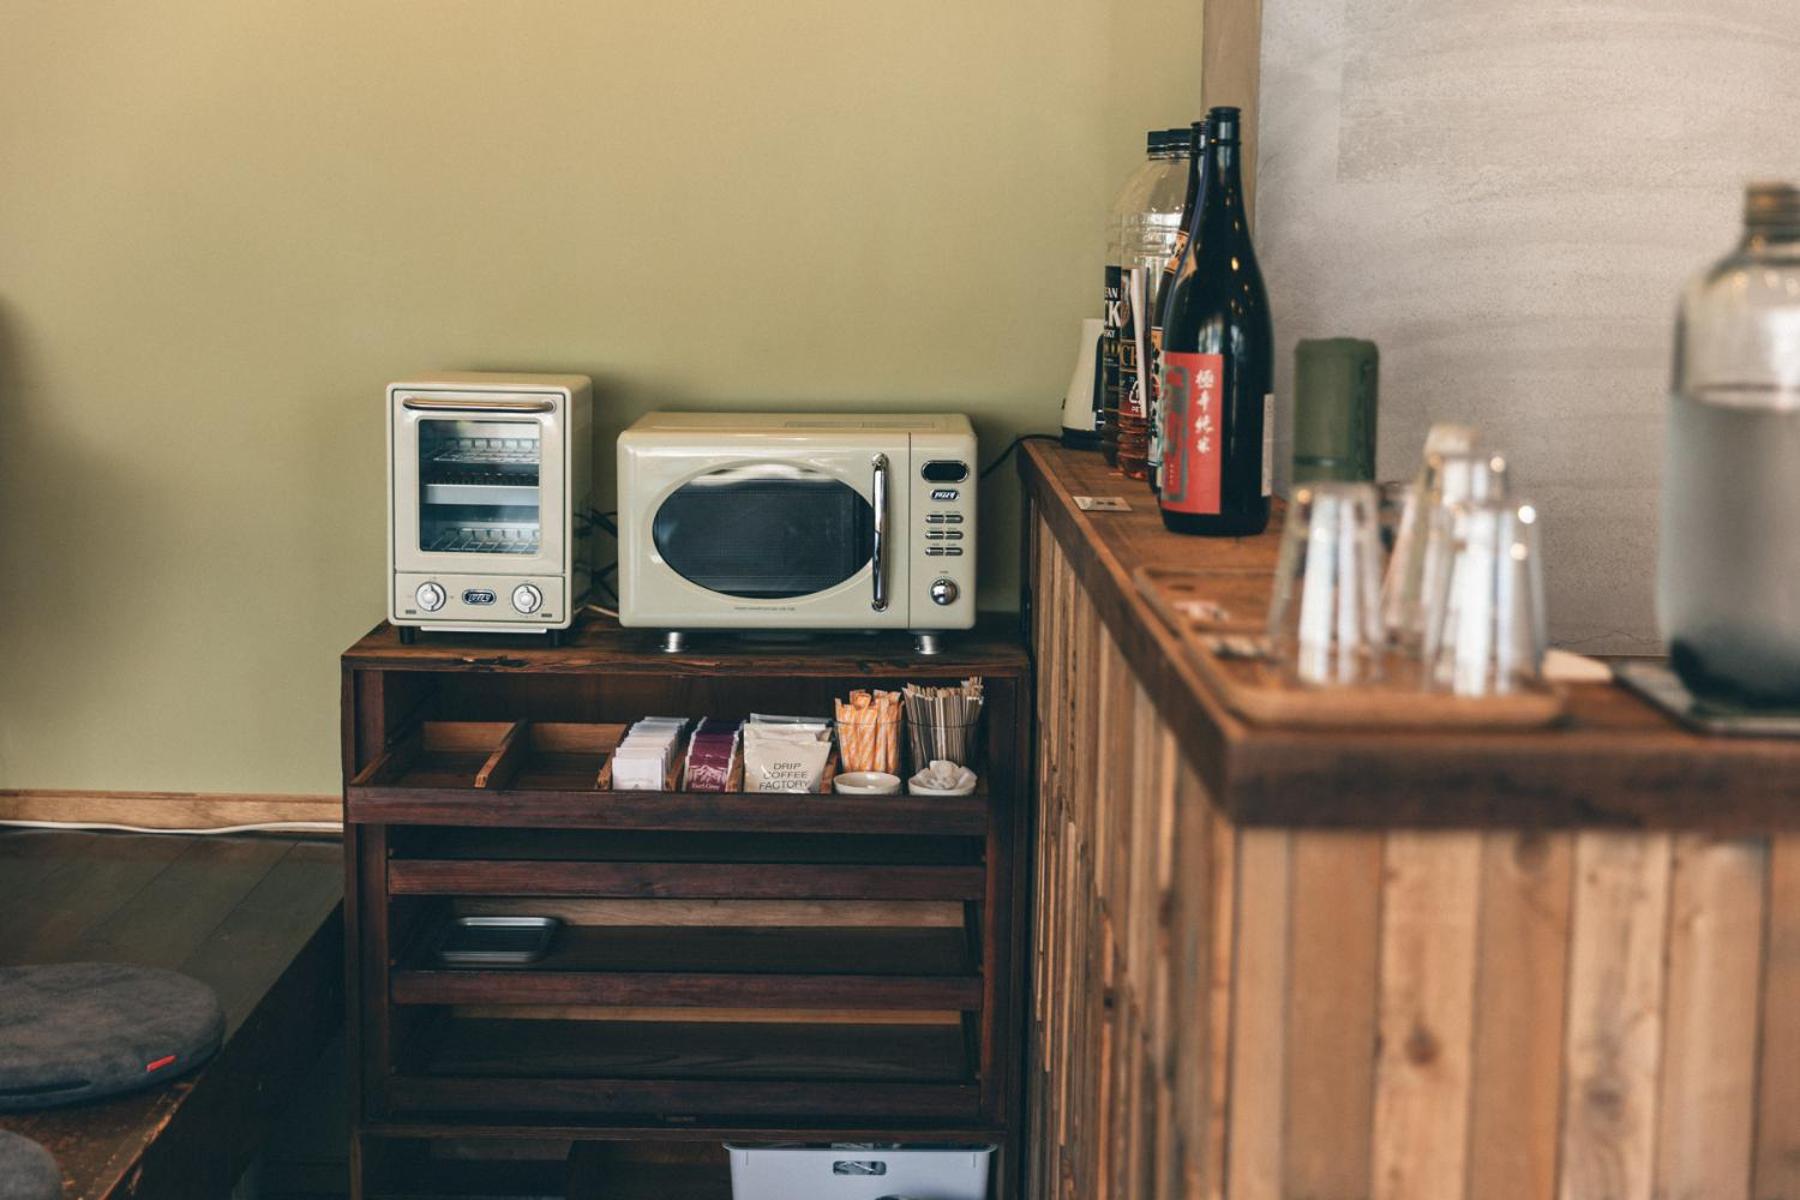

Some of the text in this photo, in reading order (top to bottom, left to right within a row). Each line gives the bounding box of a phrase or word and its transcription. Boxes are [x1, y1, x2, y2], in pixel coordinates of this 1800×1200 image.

[773, 762, 802, 770] DRIP
[763, 771, 809, 779] COFFEE
[759, 780, 809, 790] FACTORY
